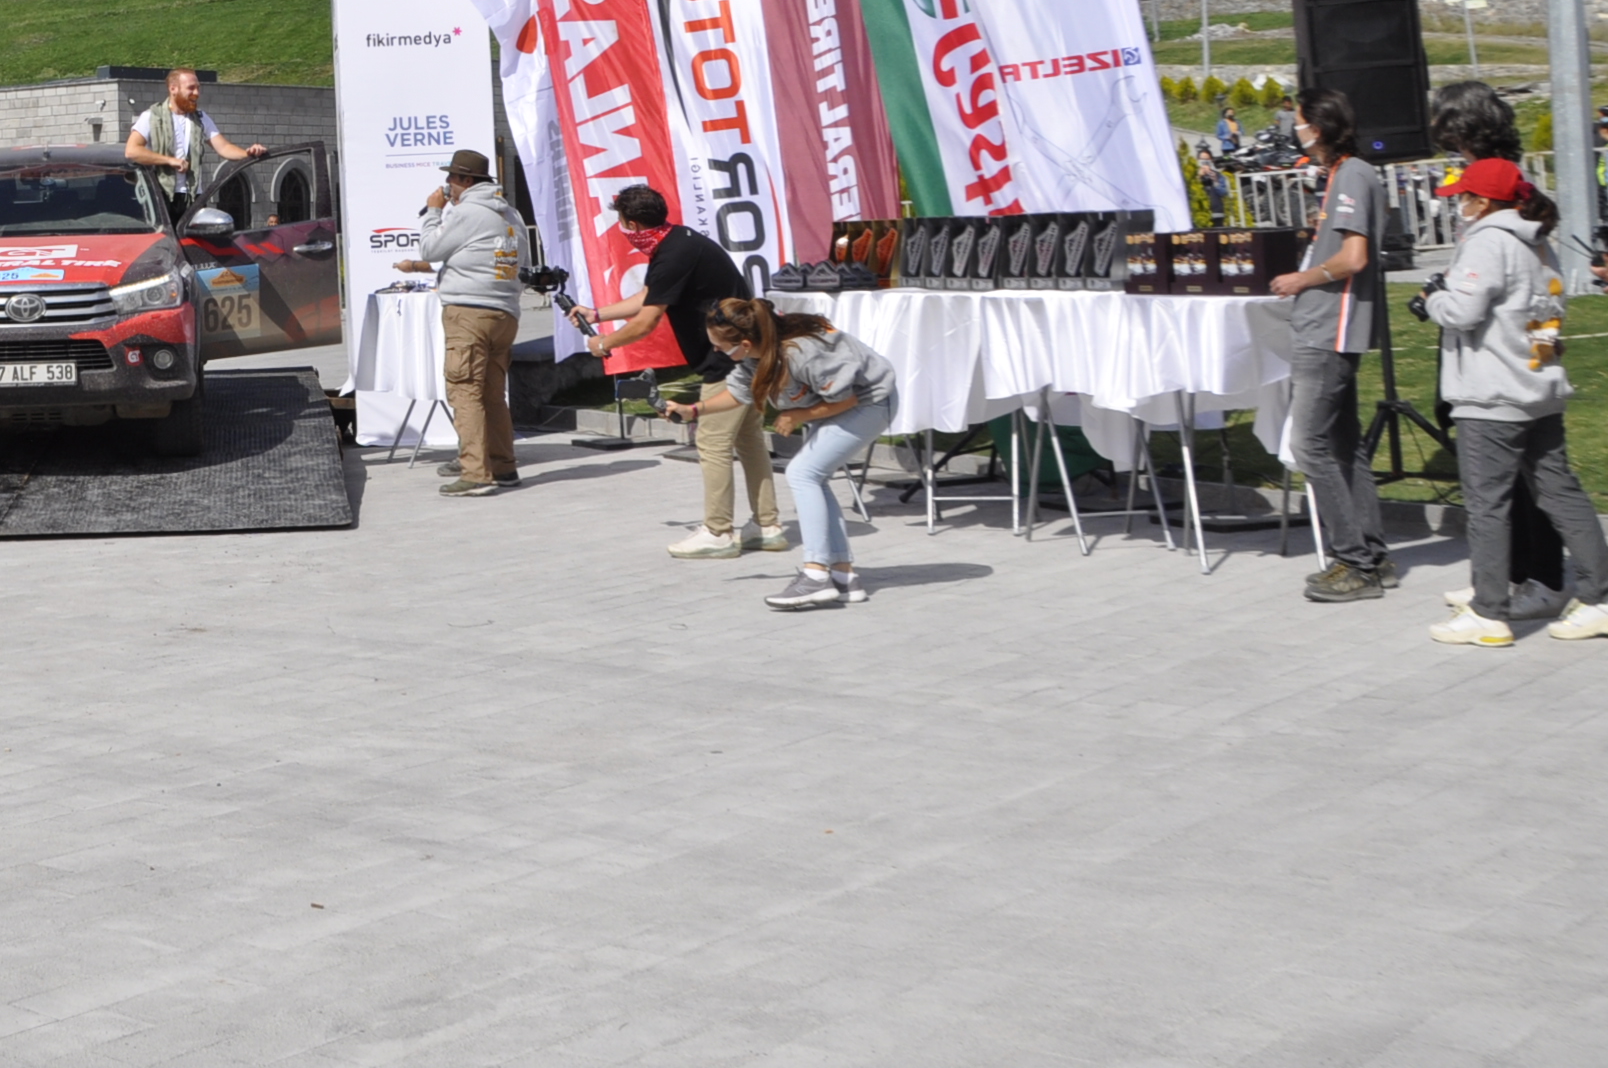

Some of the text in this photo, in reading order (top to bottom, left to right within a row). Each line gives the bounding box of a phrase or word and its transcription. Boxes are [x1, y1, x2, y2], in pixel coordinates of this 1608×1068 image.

[366, 31, 452, 48] fikirmedya
[388, 114, 450, 132] JULES
[384, 130, 455, 148] VERNE
[59, 258, 122, 269] TIRE
[203, 293, 252, 332] 625
[12, 365, 38, 381] ALF
[46, 364, 74, 380] 538
